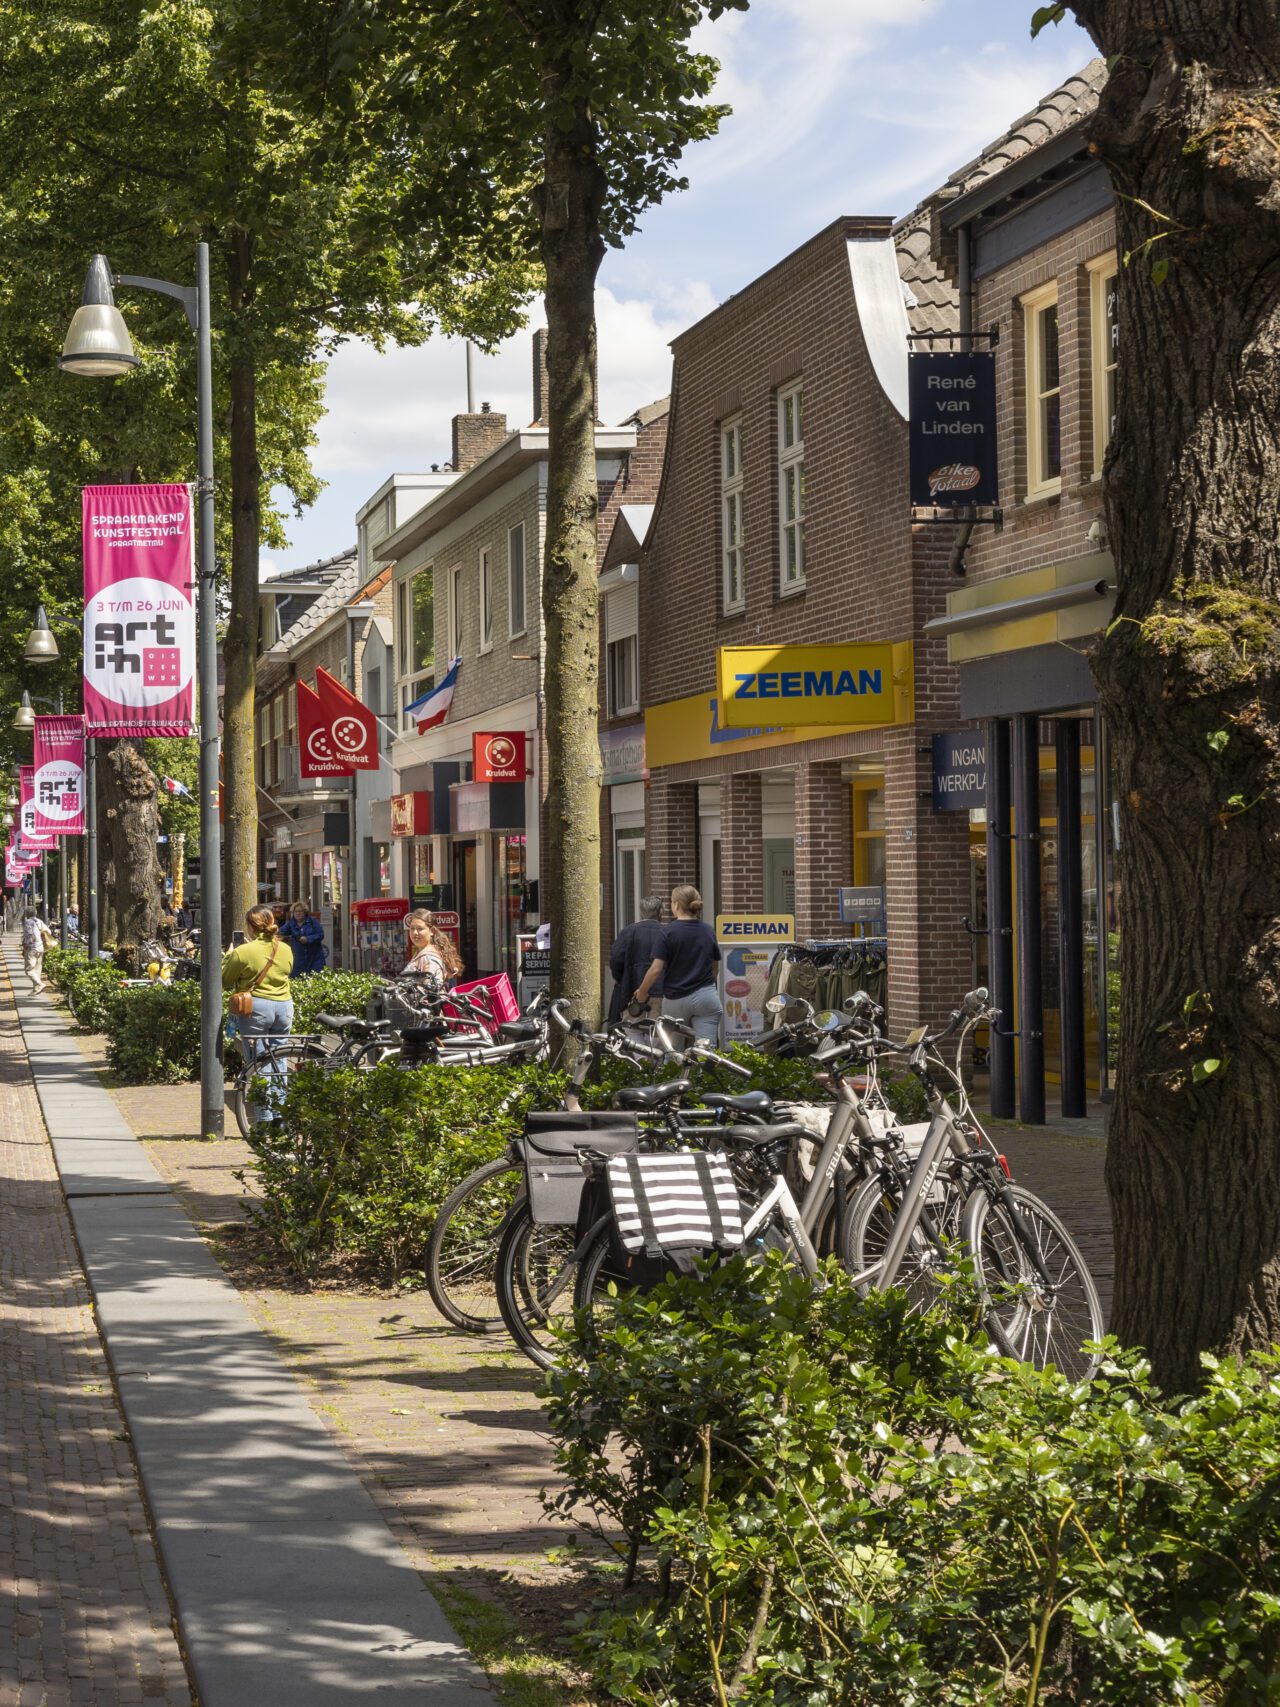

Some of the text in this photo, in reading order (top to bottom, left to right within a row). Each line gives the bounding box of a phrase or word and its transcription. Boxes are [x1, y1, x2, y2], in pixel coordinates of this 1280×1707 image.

[927, 374, 977, 389] René
[936, 400, 970, 411] van
[921, 420, 984, 434] Linden
[938, 463, 974, 476] Bike
[929, 472, 977, 497] Totaal
[91, 512, 185, 525] SPRAAKMAKEND
[93, 525, 184, 538] KUNSTFESTIVAL
[96, 602, 104, 612] 3
[137, 601, 153, 611] 26
[157, 600, 184, 611] JUNI
[95, 614, 175, 645] art
[734, 669, 882, 699] ZEEMAN
[335, 751, 369, 763] Kruidvat
[485, 769, 517, 777] Kruidvat
[40, 777, 77, 792] art
[722, 922, 789, 935] ZEEMAN
[825, 1143, 846, 1180] STELLA
[919, 1160, 940, 1200] STELLA
